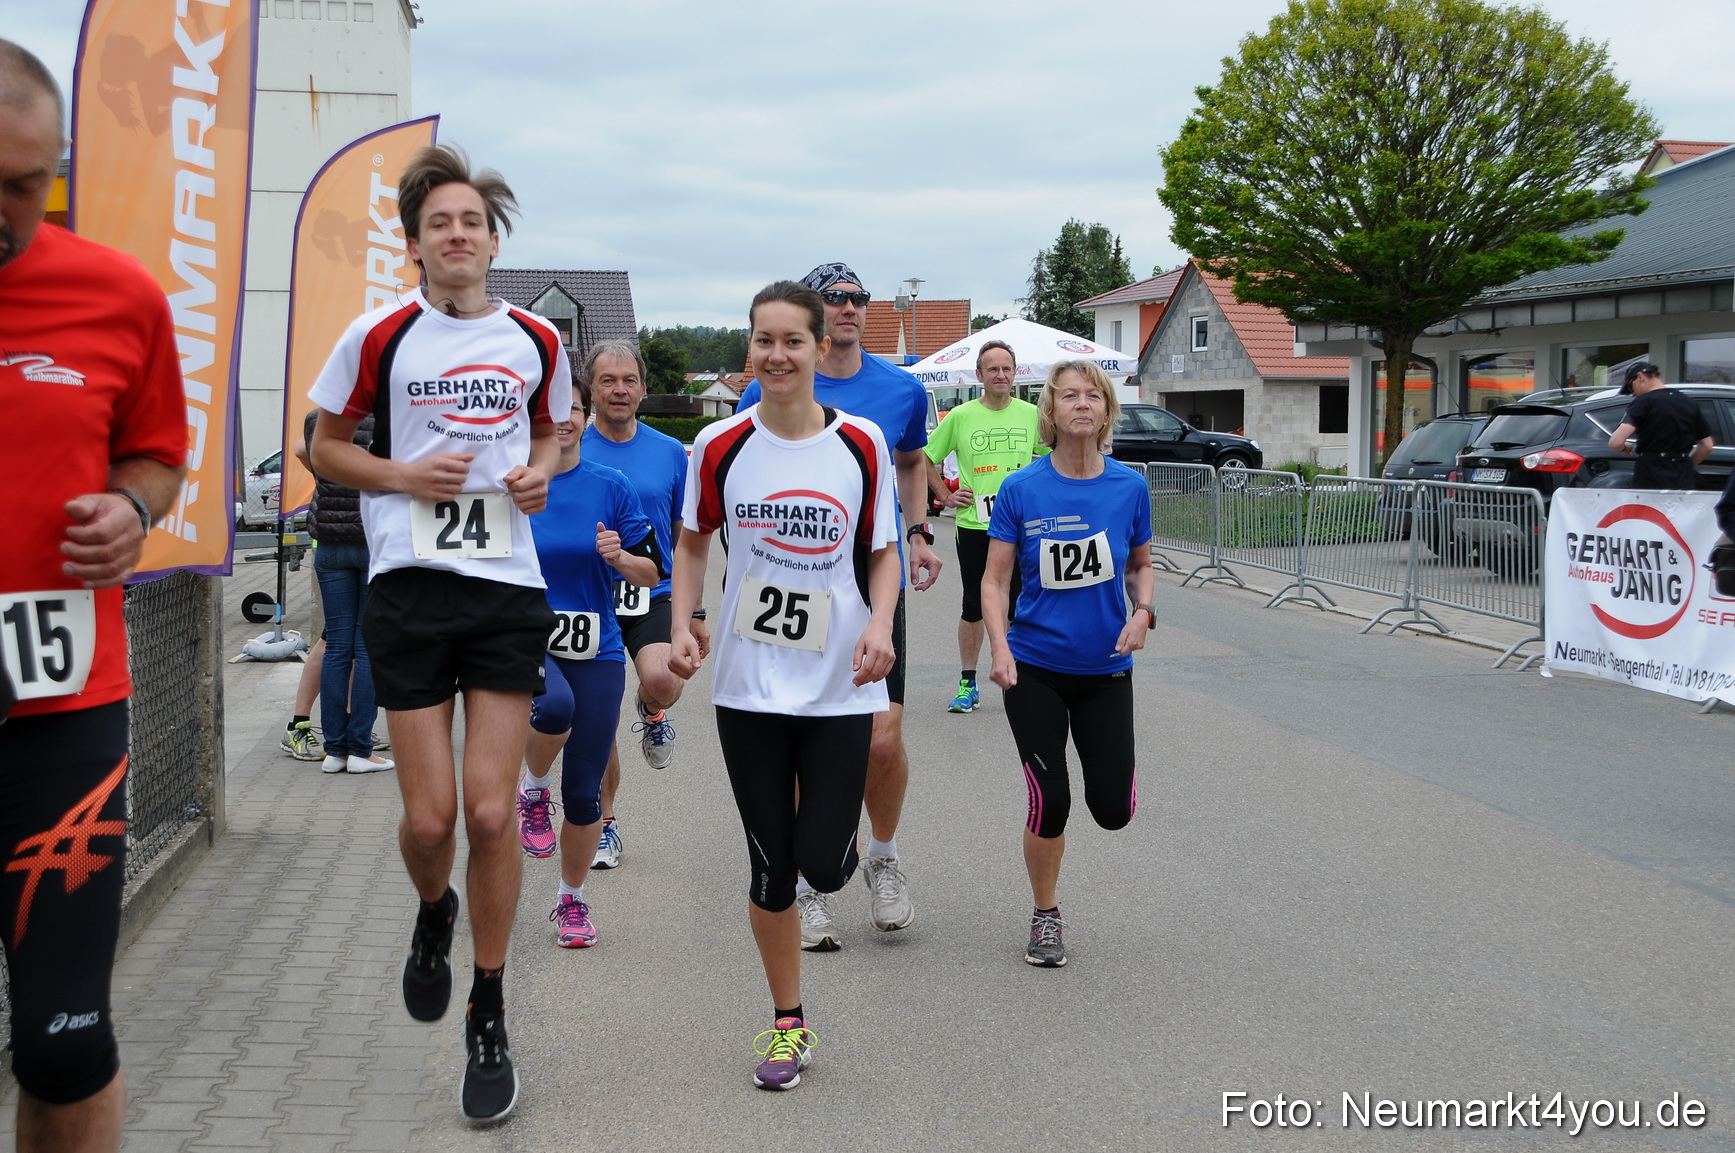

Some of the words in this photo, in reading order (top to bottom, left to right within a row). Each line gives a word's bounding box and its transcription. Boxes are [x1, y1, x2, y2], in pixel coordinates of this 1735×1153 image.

[407, 378, 510, 396] GERHART
[410, 398, 458, 406] Autohaus
[457, 394, 517, 410] JÄNIG
[427, 420, 445, 435] Das
[445, 430, 493, 442] sportliche
[970, 428, 1027, 452] OPF
[974, 465, 998, 474] MERZ
[435, 499, 490, 550] 24
[735, 503, 831, 523] GERHART
[833, 515, 839, 523] &
[738, 520, 778, 528] Autohaus
[777, 521, 839, 542] JÄNIG
[750, 543, 764, 557] Das
[765, 553, 809, 571] sportliche
[811, 553, 843, 572] Autohaus
[1049, 539, 1102, 582] 124
[1566, 532, 1663, 571] GERHART
[1668, 549, 1678, 565] &
[1568, 563, 1614, 584] Autohaus
[1611, 569, 1682, 606] JÄNIG
[754, 586, 810, 640] 25
[3, 599, 74, 684] 15
[549, 613, 591, 654] 28
[1554, 640, 1606, 669] Neumarkt
[1671, 663, 1683, 687] Tel.
[69, 1011, 99, 1029] asics
